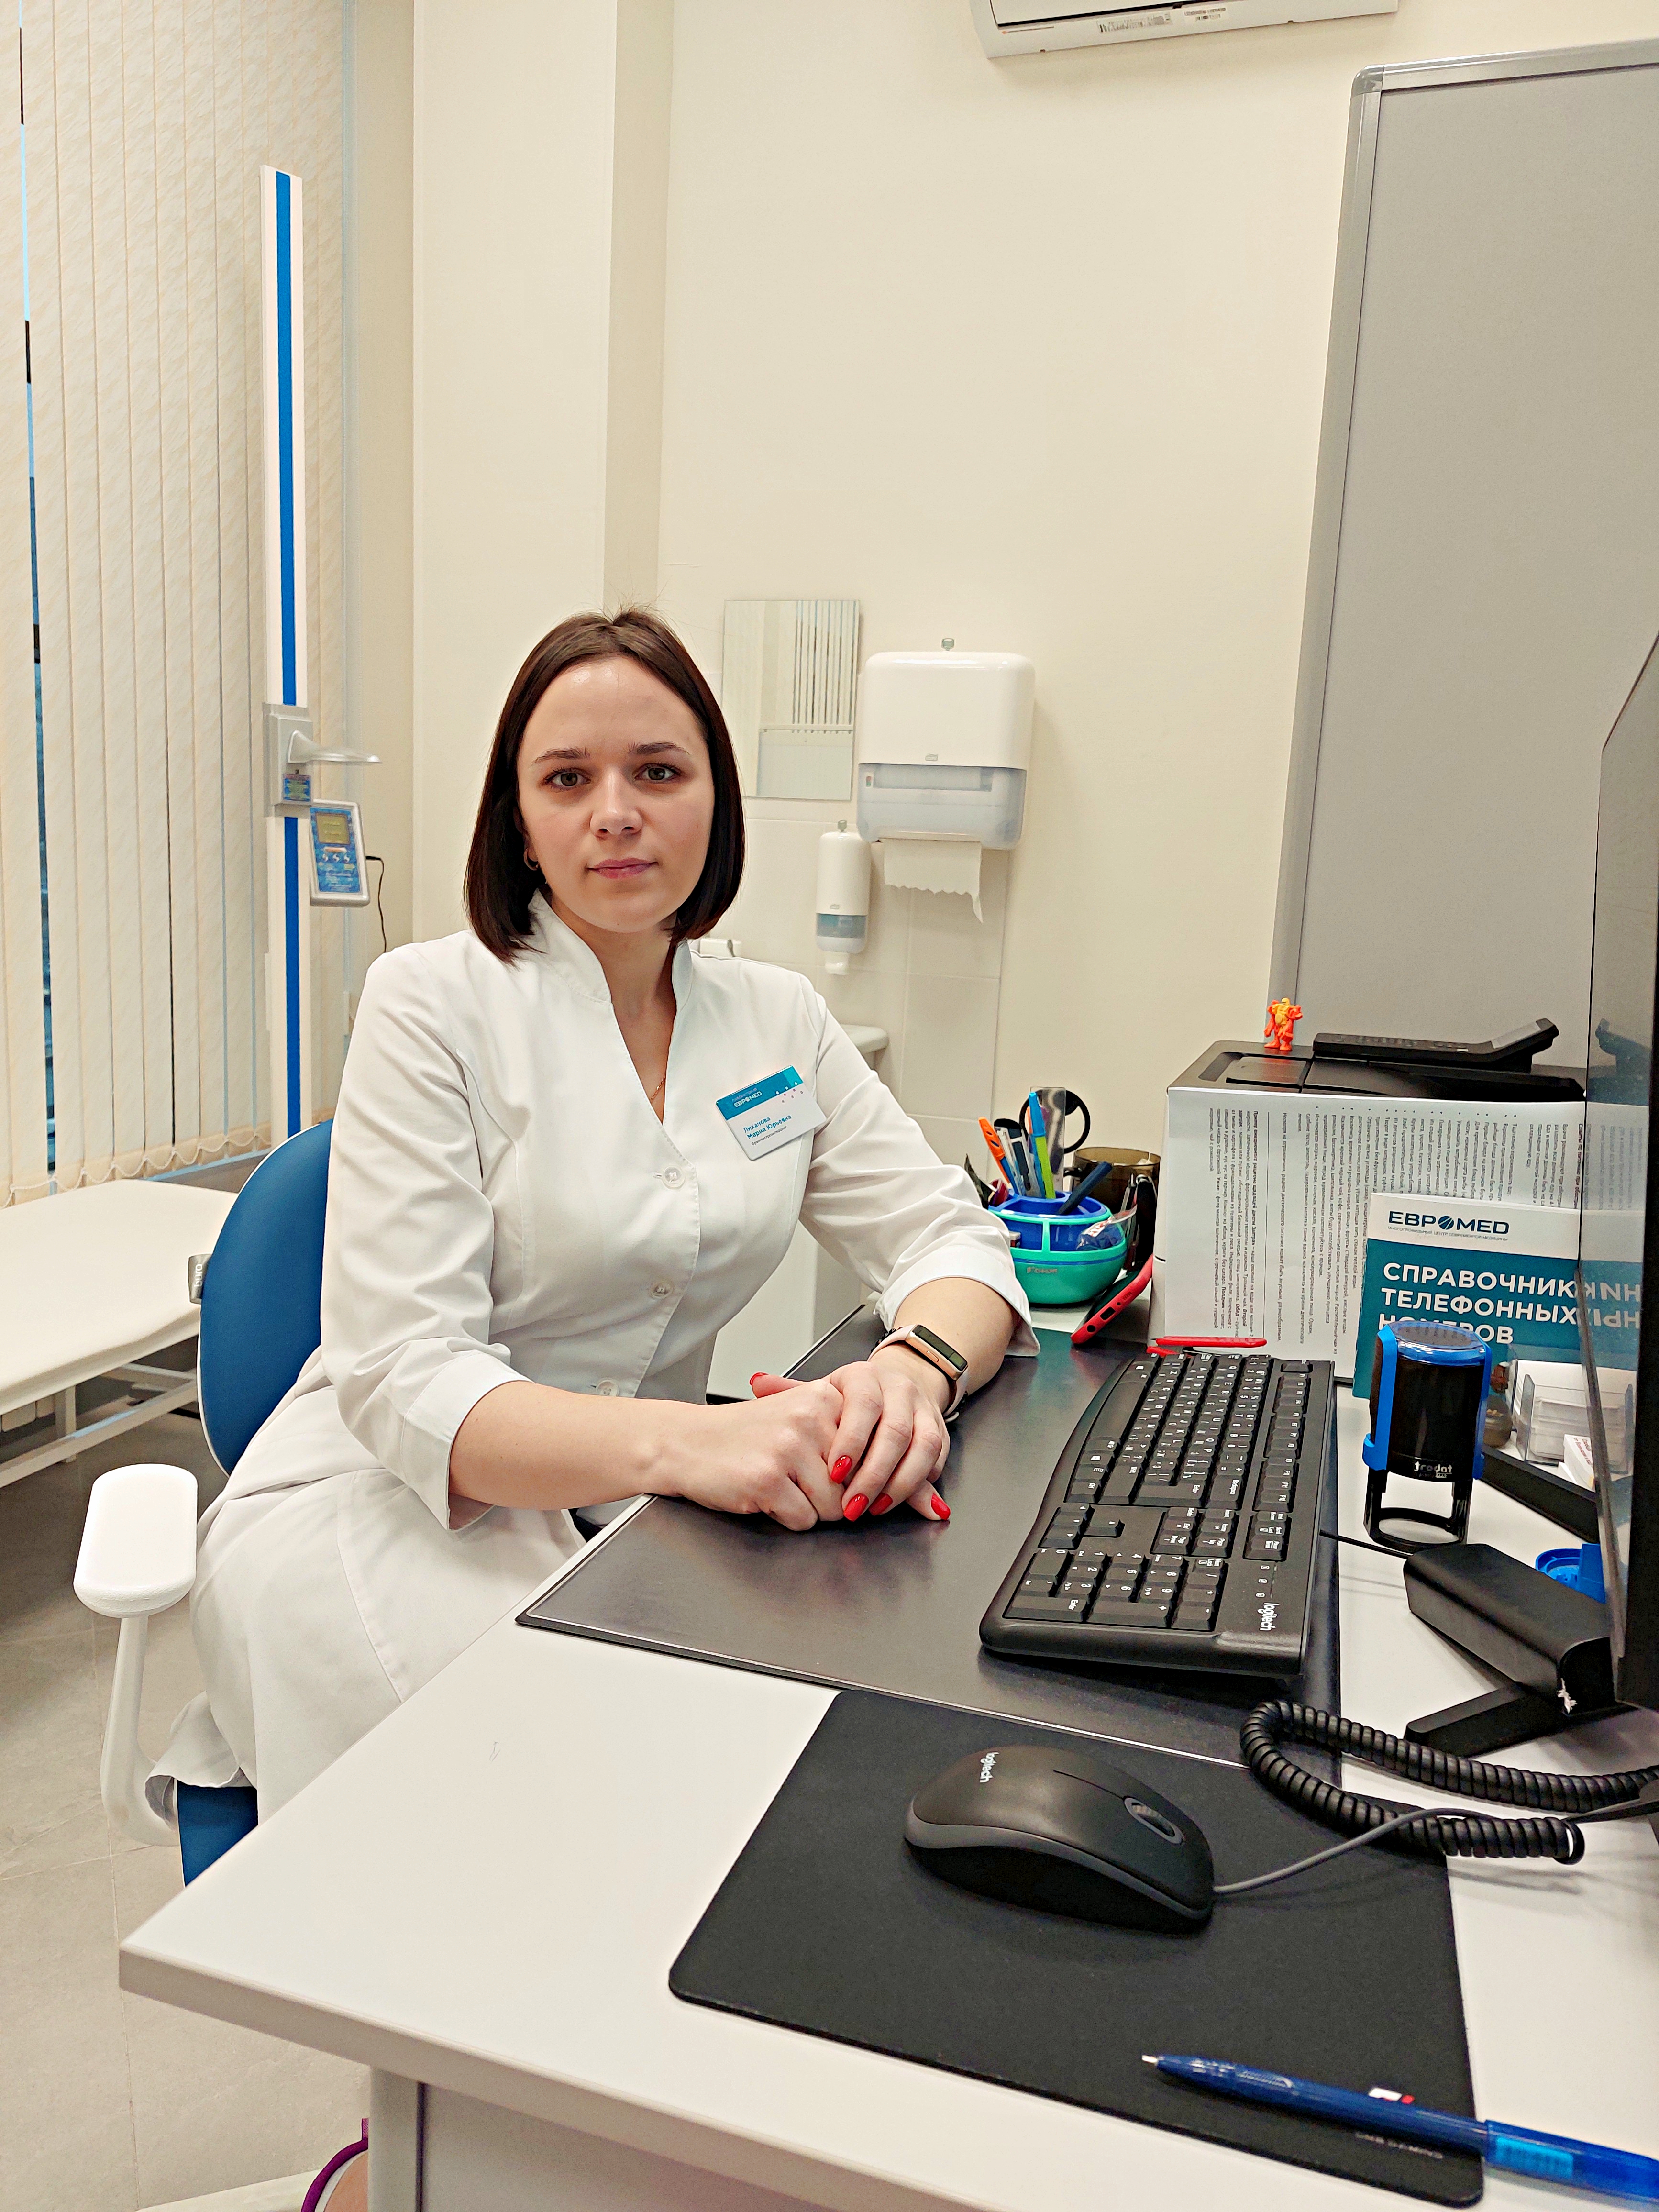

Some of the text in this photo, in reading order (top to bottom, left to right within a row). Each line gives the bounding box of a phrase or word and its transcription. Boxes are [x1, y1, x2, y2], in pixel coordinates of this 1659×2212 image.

[747, 1115, 792, 1140] Мария Юрьевна
[1383, 1262, 1577, 1298] СПРАВОЧНИК
[1381, 1287, 1577, 1325] ТЕЛЕФОННЫХ
[1415, 1461, 1453, 1473] trodat
[1192, 1484, 1200, 1493] Enter
[1229, 1479, 1239, 1495] Backspace
[1068, 1599, 1079, 1610] Enter
[1257, 1603, 1280, 1631] logitech
[979, 1751, 999, 1783] logitech
